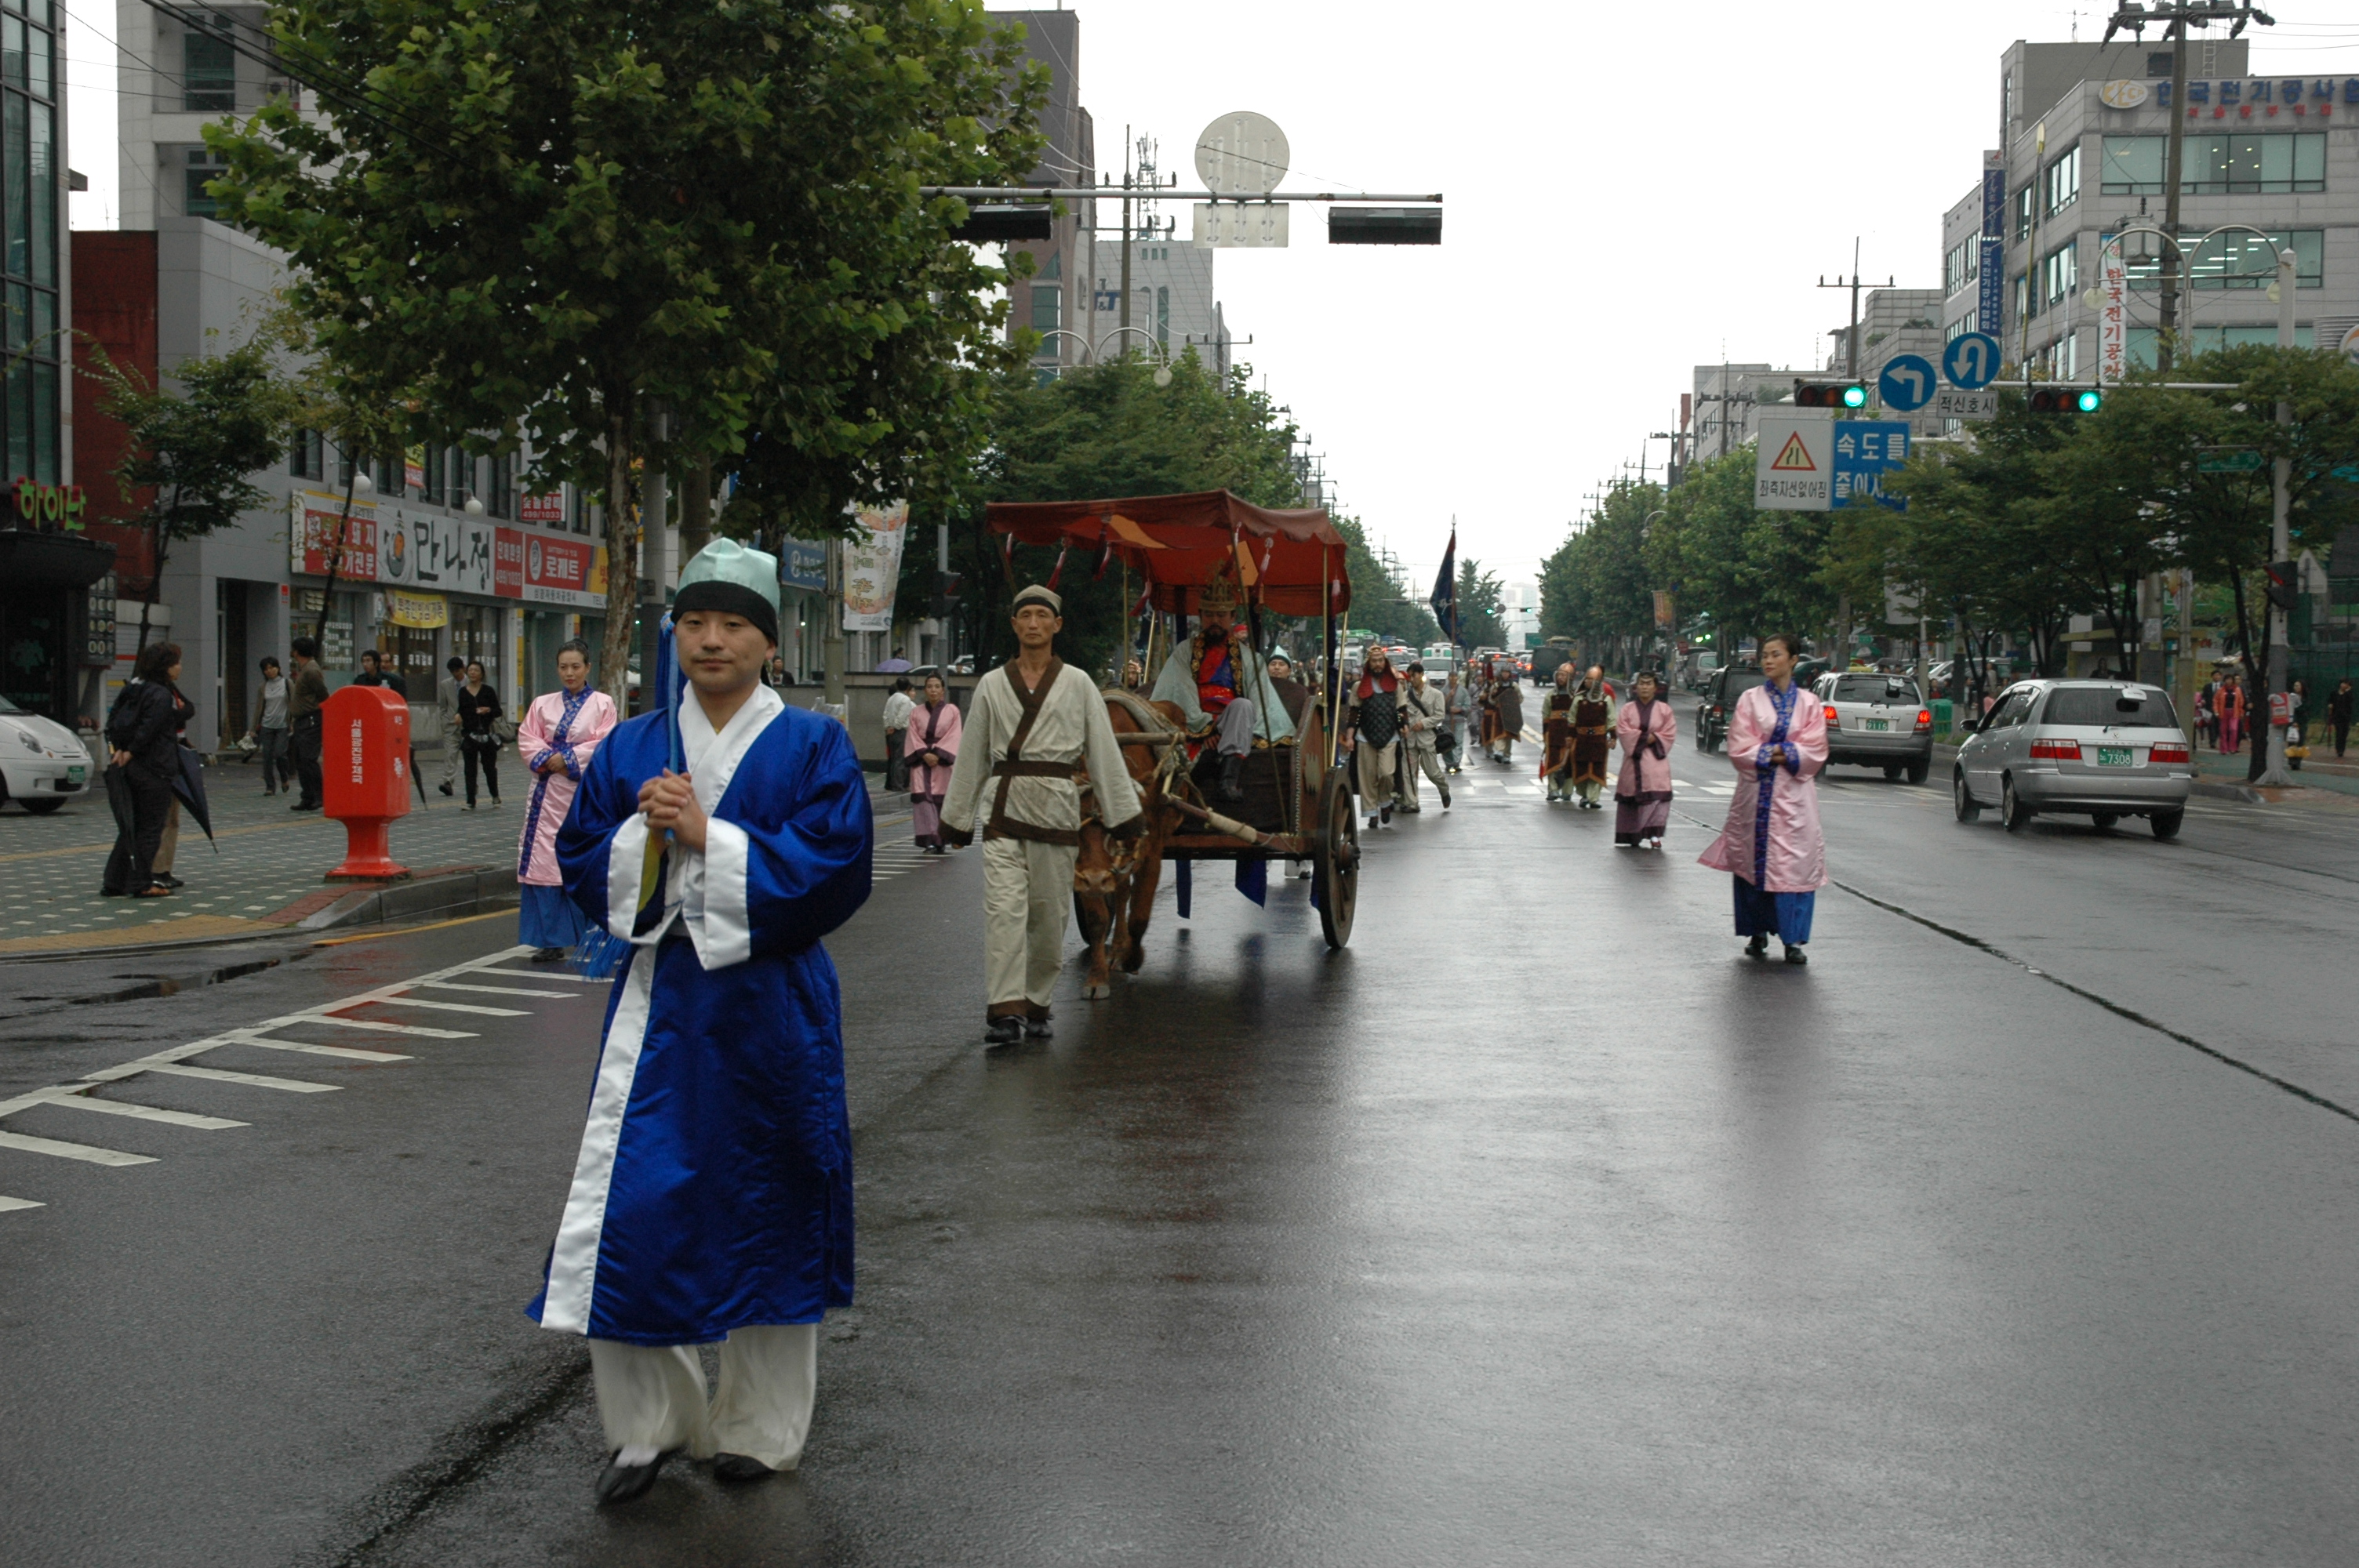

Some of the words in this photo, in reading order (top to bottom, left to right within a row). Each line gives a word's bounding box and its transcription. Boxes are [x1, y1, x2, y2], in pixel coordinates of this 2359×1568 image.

[1981, 246, 1992, 330] 한국전기공사협회
[1940, 397, 1995, 414] 적신호시
[1837, 433, 1905, 460] 속도를
[1759, 479, 1827, 499] 좌측차선없어짐
[1835, 471, 1903, 499] 줄이시
[19, 476, 87, 531] 하이난
[523, 510, 560, 519] 499/1033
[546, 555, 580, 581] 로케트
[351, 719, 363, 785] 서울광진우체국
[2107, 753, 2131, 764] 7308
